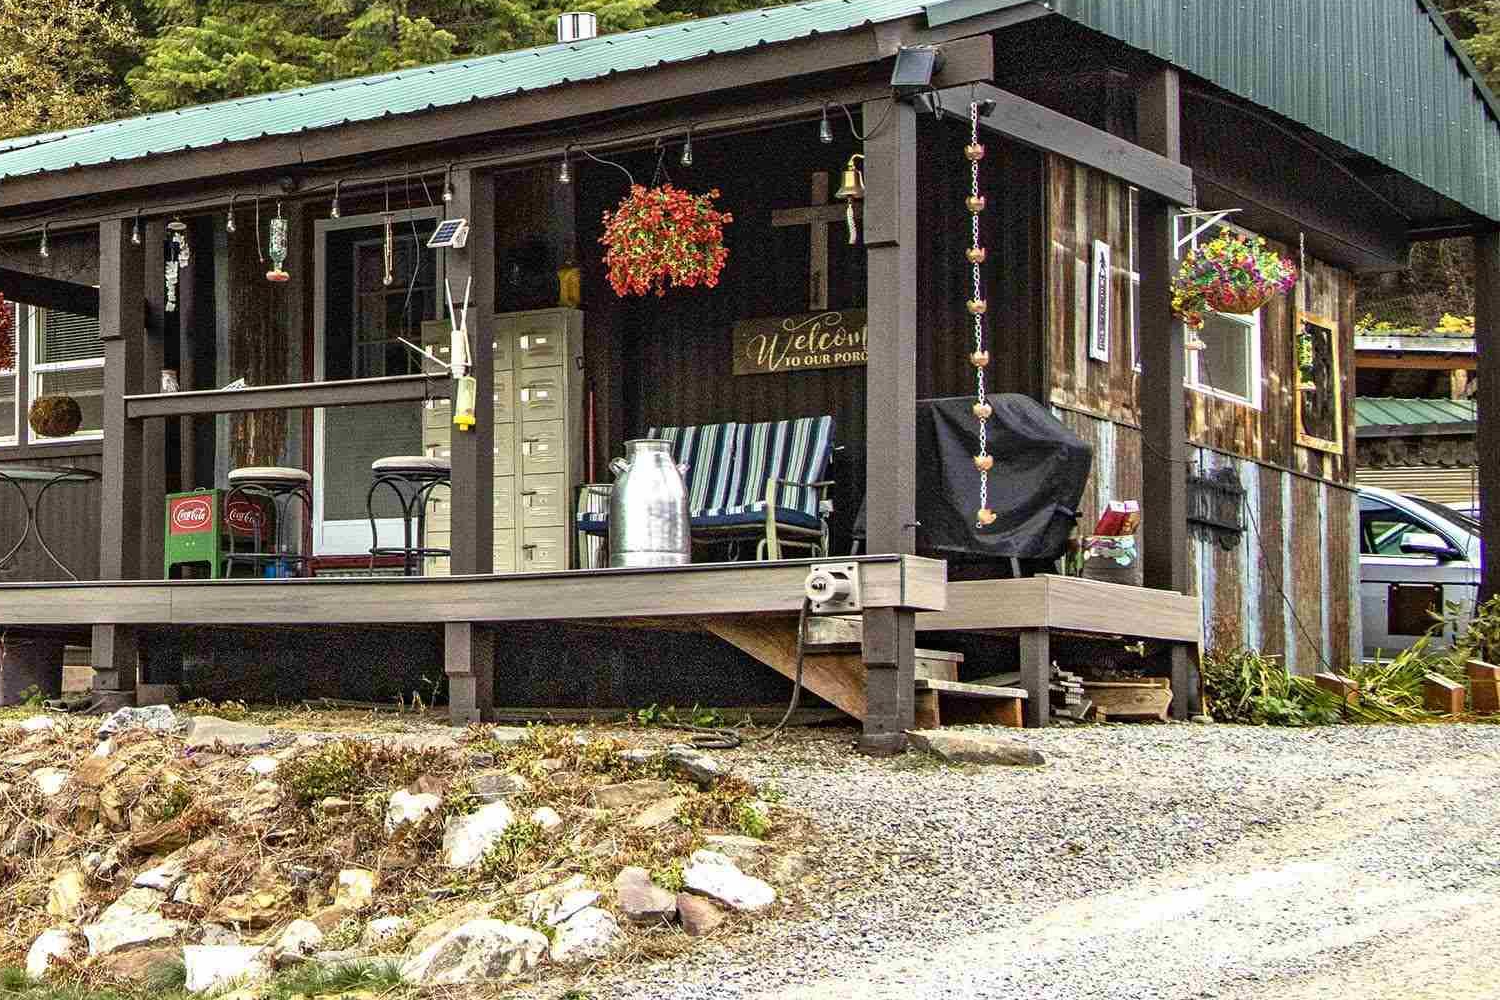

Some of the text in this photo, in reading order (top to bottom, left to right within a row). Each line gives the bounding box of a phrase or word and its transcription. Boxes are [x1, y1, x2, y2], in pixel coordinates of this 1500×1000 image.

[747, 311, 868, 371] Welcom
[803, 354, 831, 366] OUR
[834, 351, 868, 363] PORC
[177, 507, 206, 522] Coca-Cola
